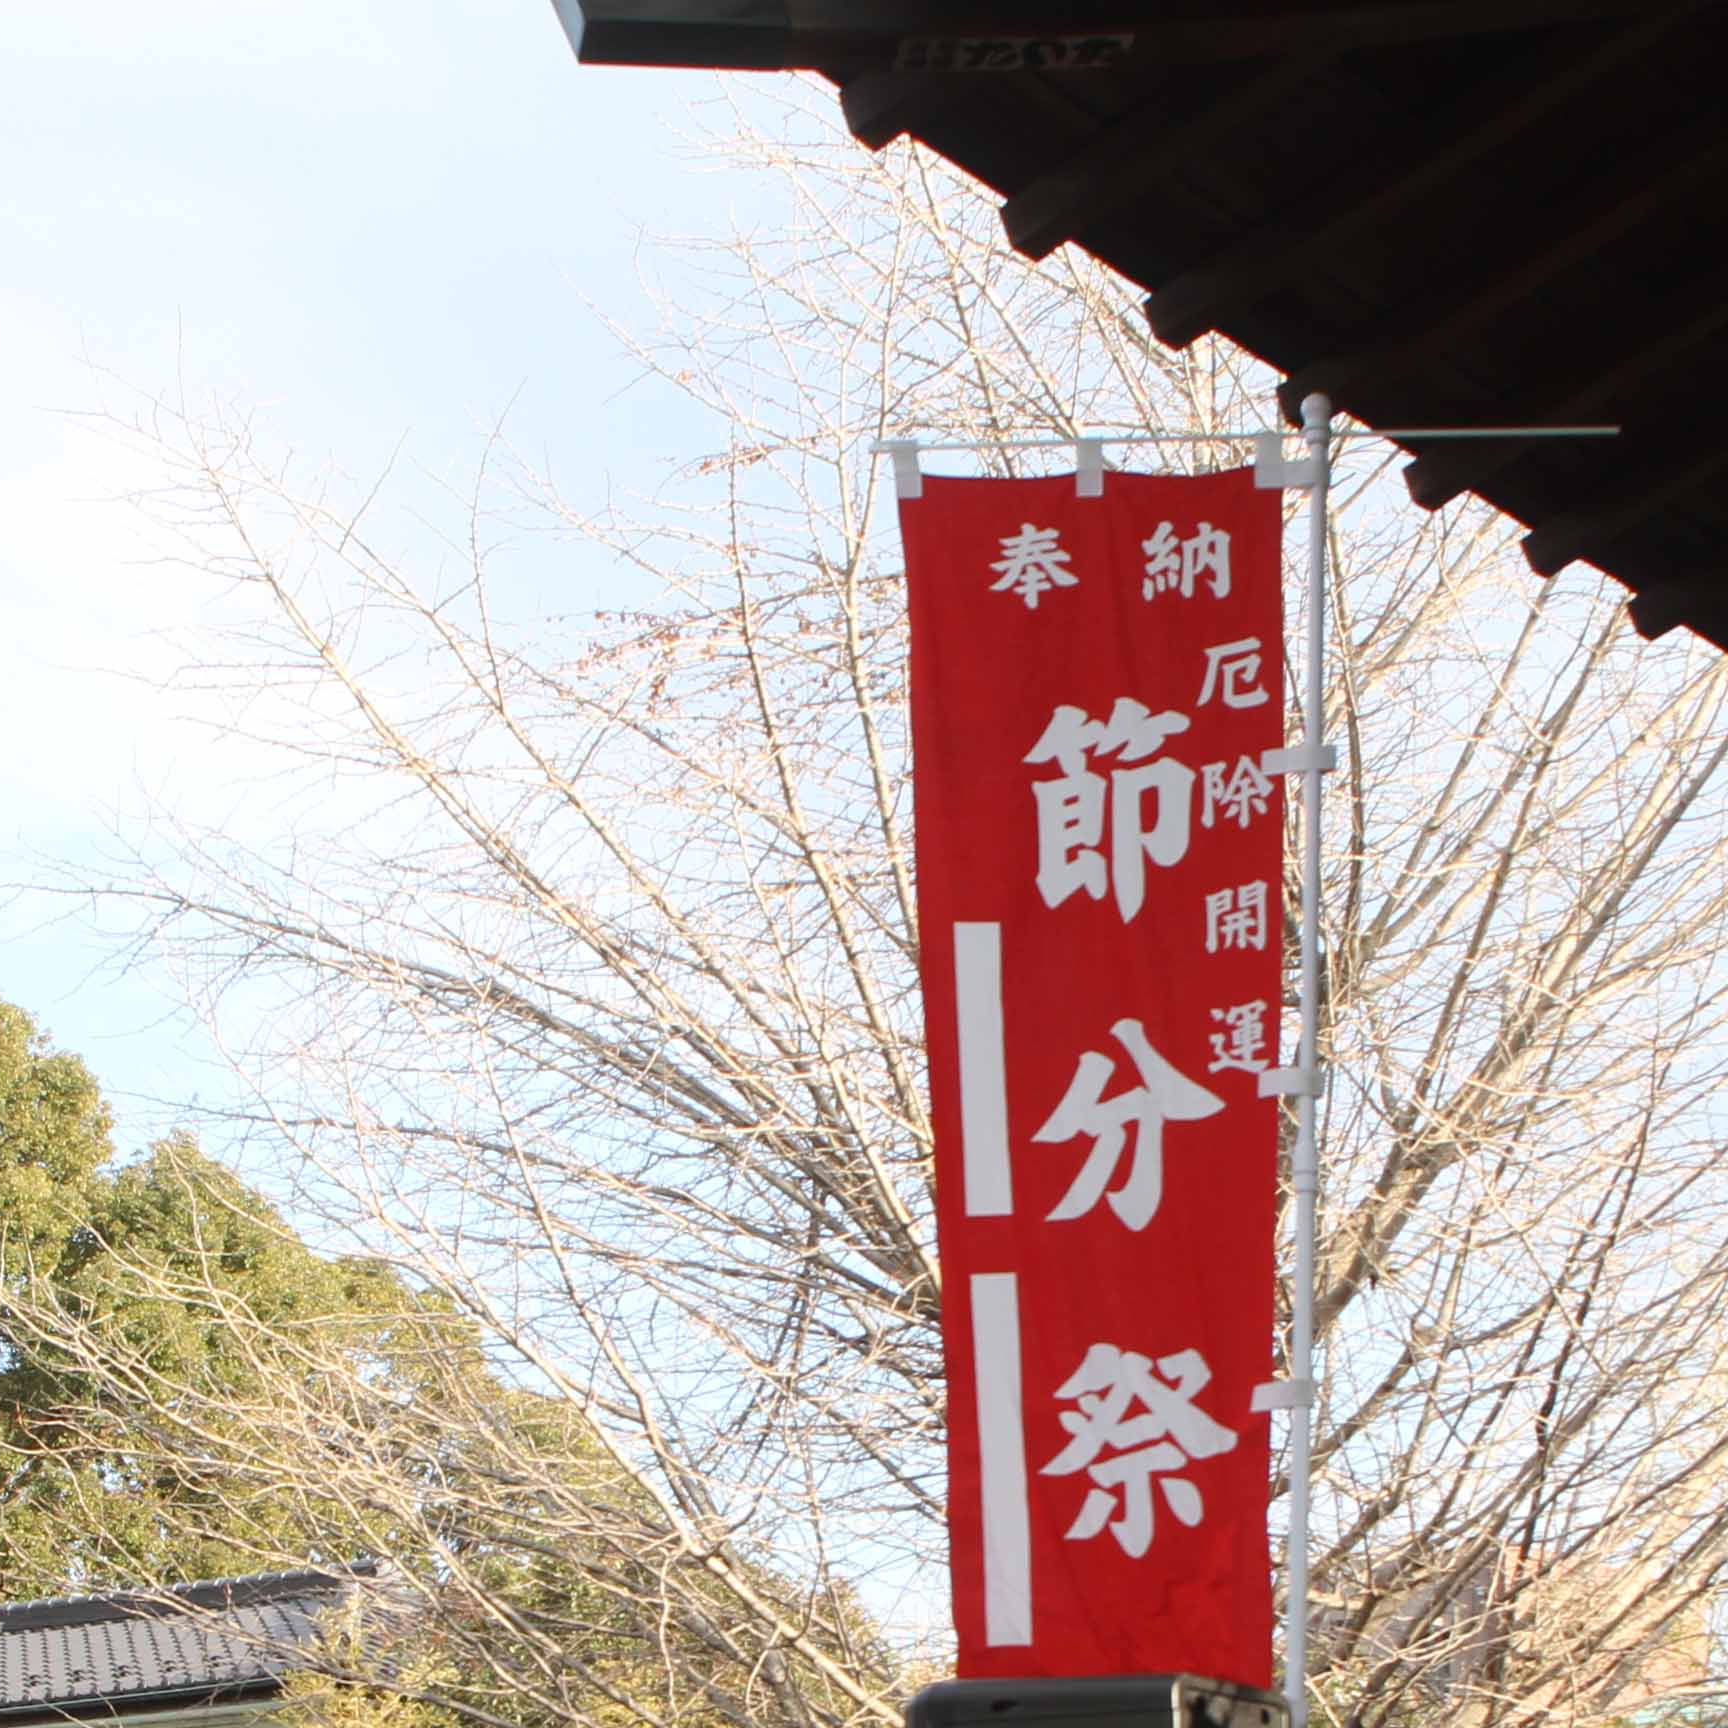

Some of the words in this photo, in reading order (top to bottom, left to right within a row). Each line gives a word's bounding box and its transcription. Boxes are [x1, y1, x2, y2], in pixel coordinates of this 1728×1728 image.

[990, 521, 1231, 609] 奉納
[1197, 637, 1273, 1074] 厄除開運
[1023, 697, 1238, 1558] 節分祭
